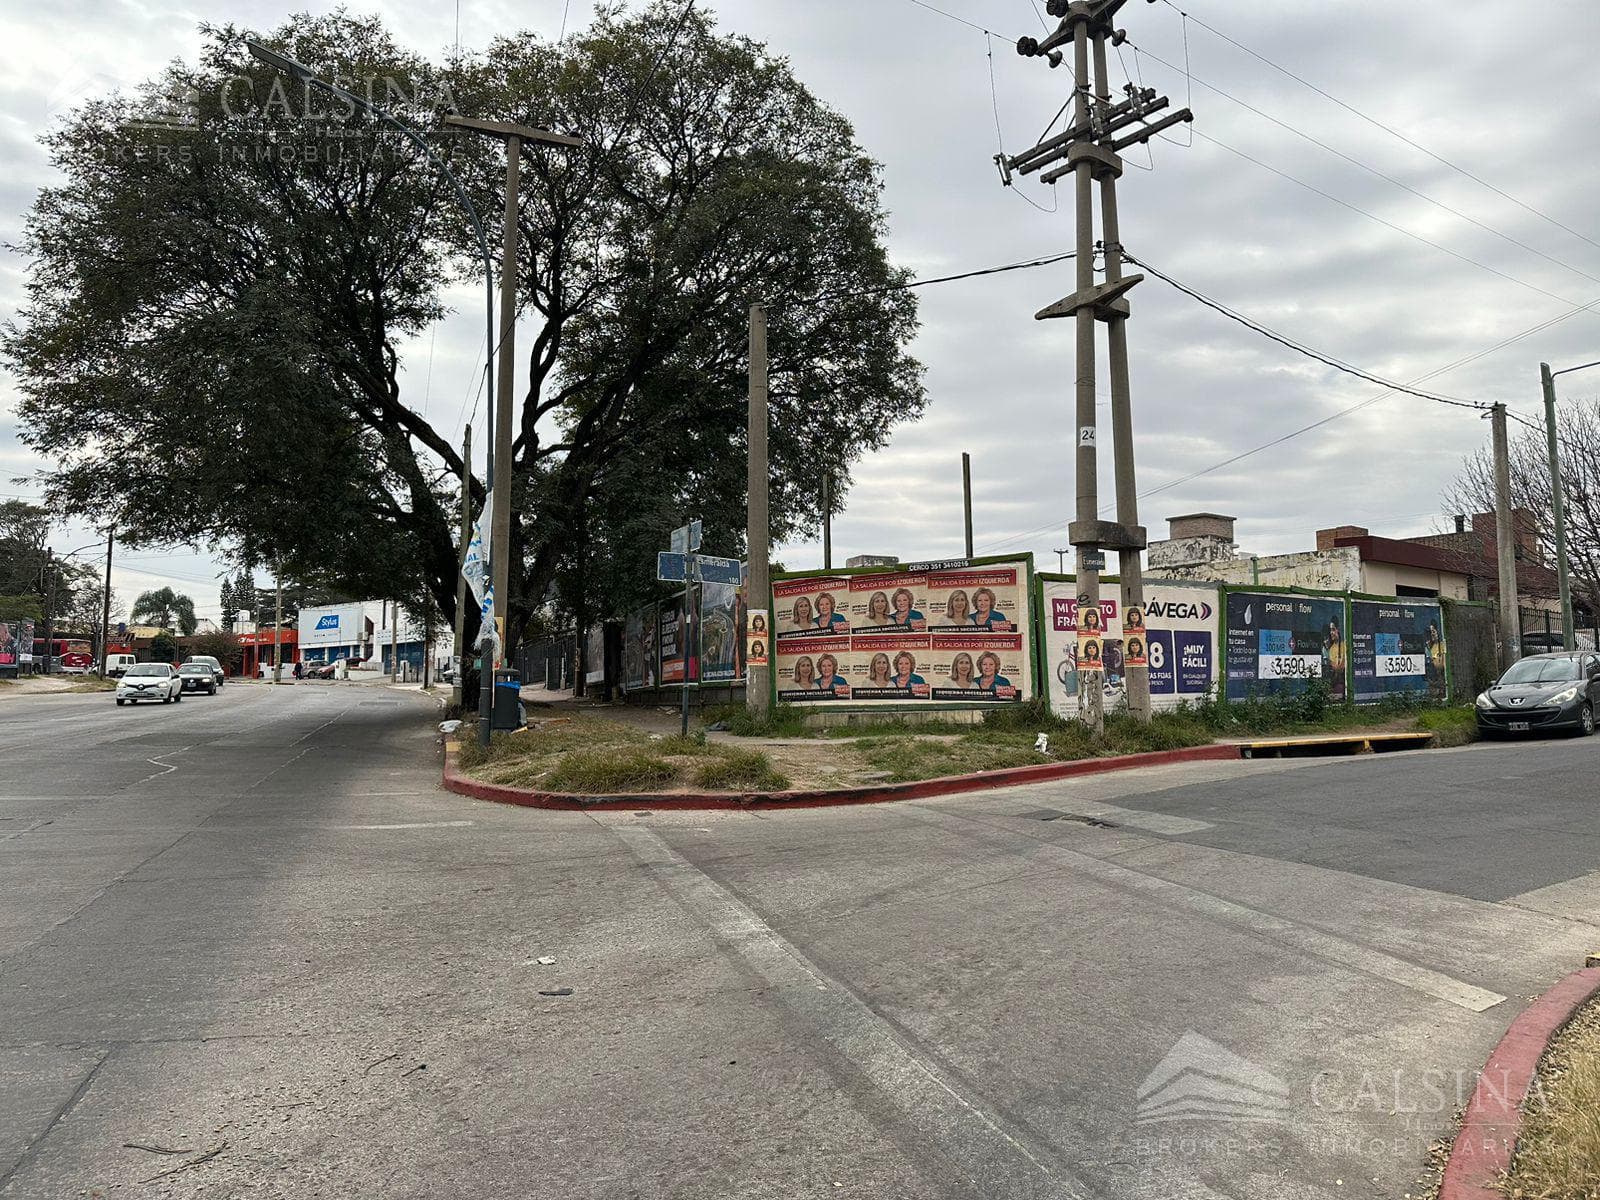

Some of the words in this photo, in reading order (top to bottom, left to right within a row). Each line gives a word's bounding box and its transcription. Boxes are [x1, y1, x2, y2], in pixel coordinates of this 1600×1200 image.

[1082, 430, 1095, 440] 24
[1056, 603, 1069, 613] MI
[1144, 597, 1199, 619] ÁVEGA
[1265, 603, 1293, 612] personal
[1299, 603, 1313, 613] flow
[1379, 609, 1400, 618] personal
[1404, 609, 1415, 618] flow
[1057, 613, 1104, 627] FRÁA
[1149, 641, 1165, 668] 8
[1183, 644, 1205, 655] ¡MUY
[1182, 655, 1207, 668] FÁCIL!
